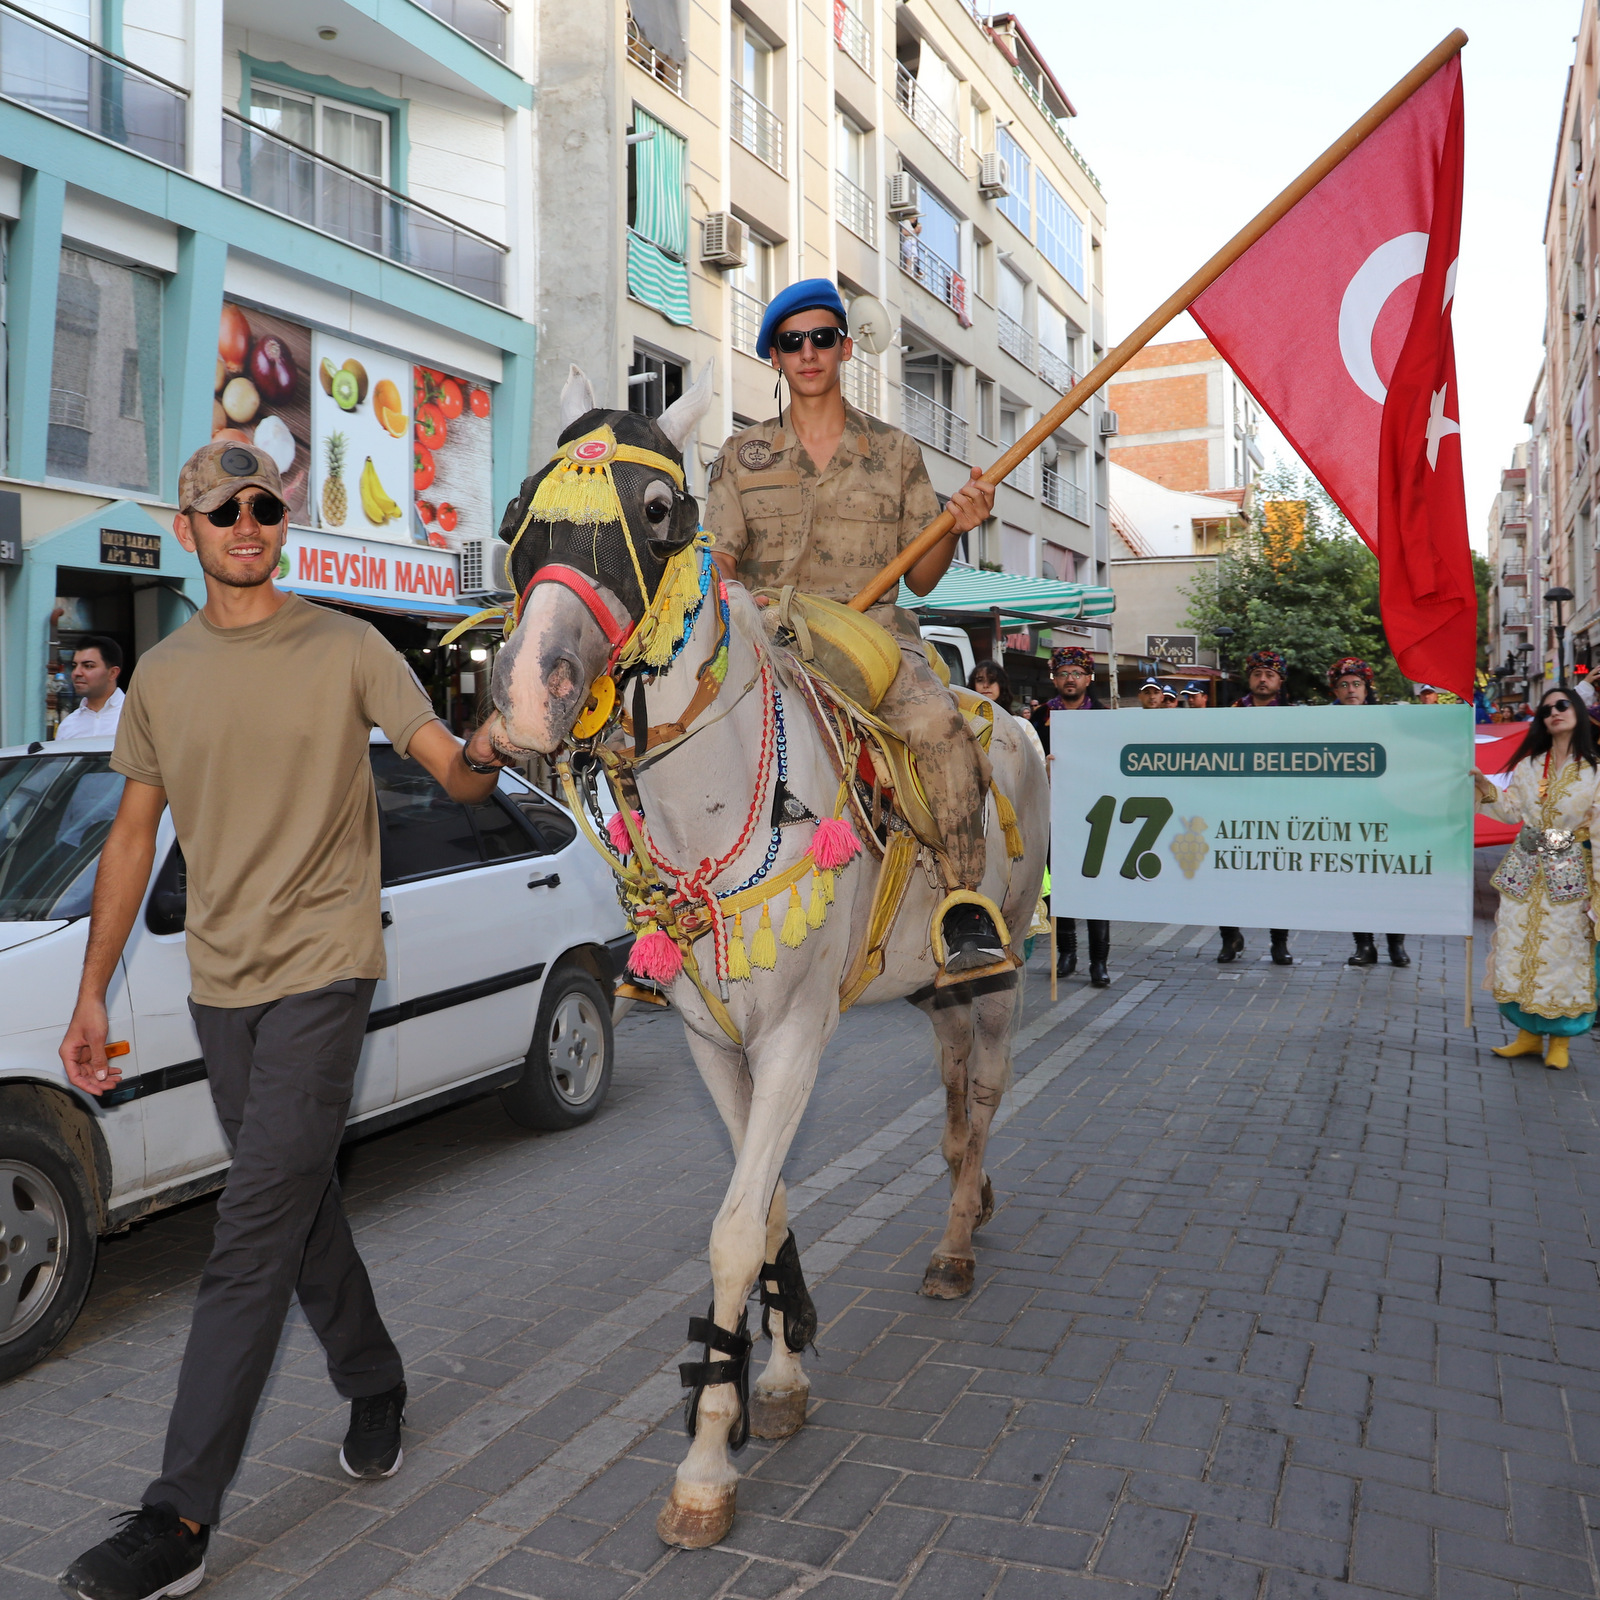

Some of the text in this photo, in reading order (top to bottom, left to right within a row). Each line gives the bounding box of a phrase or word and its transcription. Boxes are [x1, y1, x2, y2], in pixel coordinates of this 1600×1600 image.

[299, 546, 387, 590] MEVSİM
[1126, 747, 1376, 772] SARUHANLI BELEDİYESİ
[1081, 794, 1174, 882] 17.
[1214, 816, 1389, 842] ALTIN ÜZÜM VE
[1213, 846, 1433, 875] KÜLTÜR FESTİVALİ
